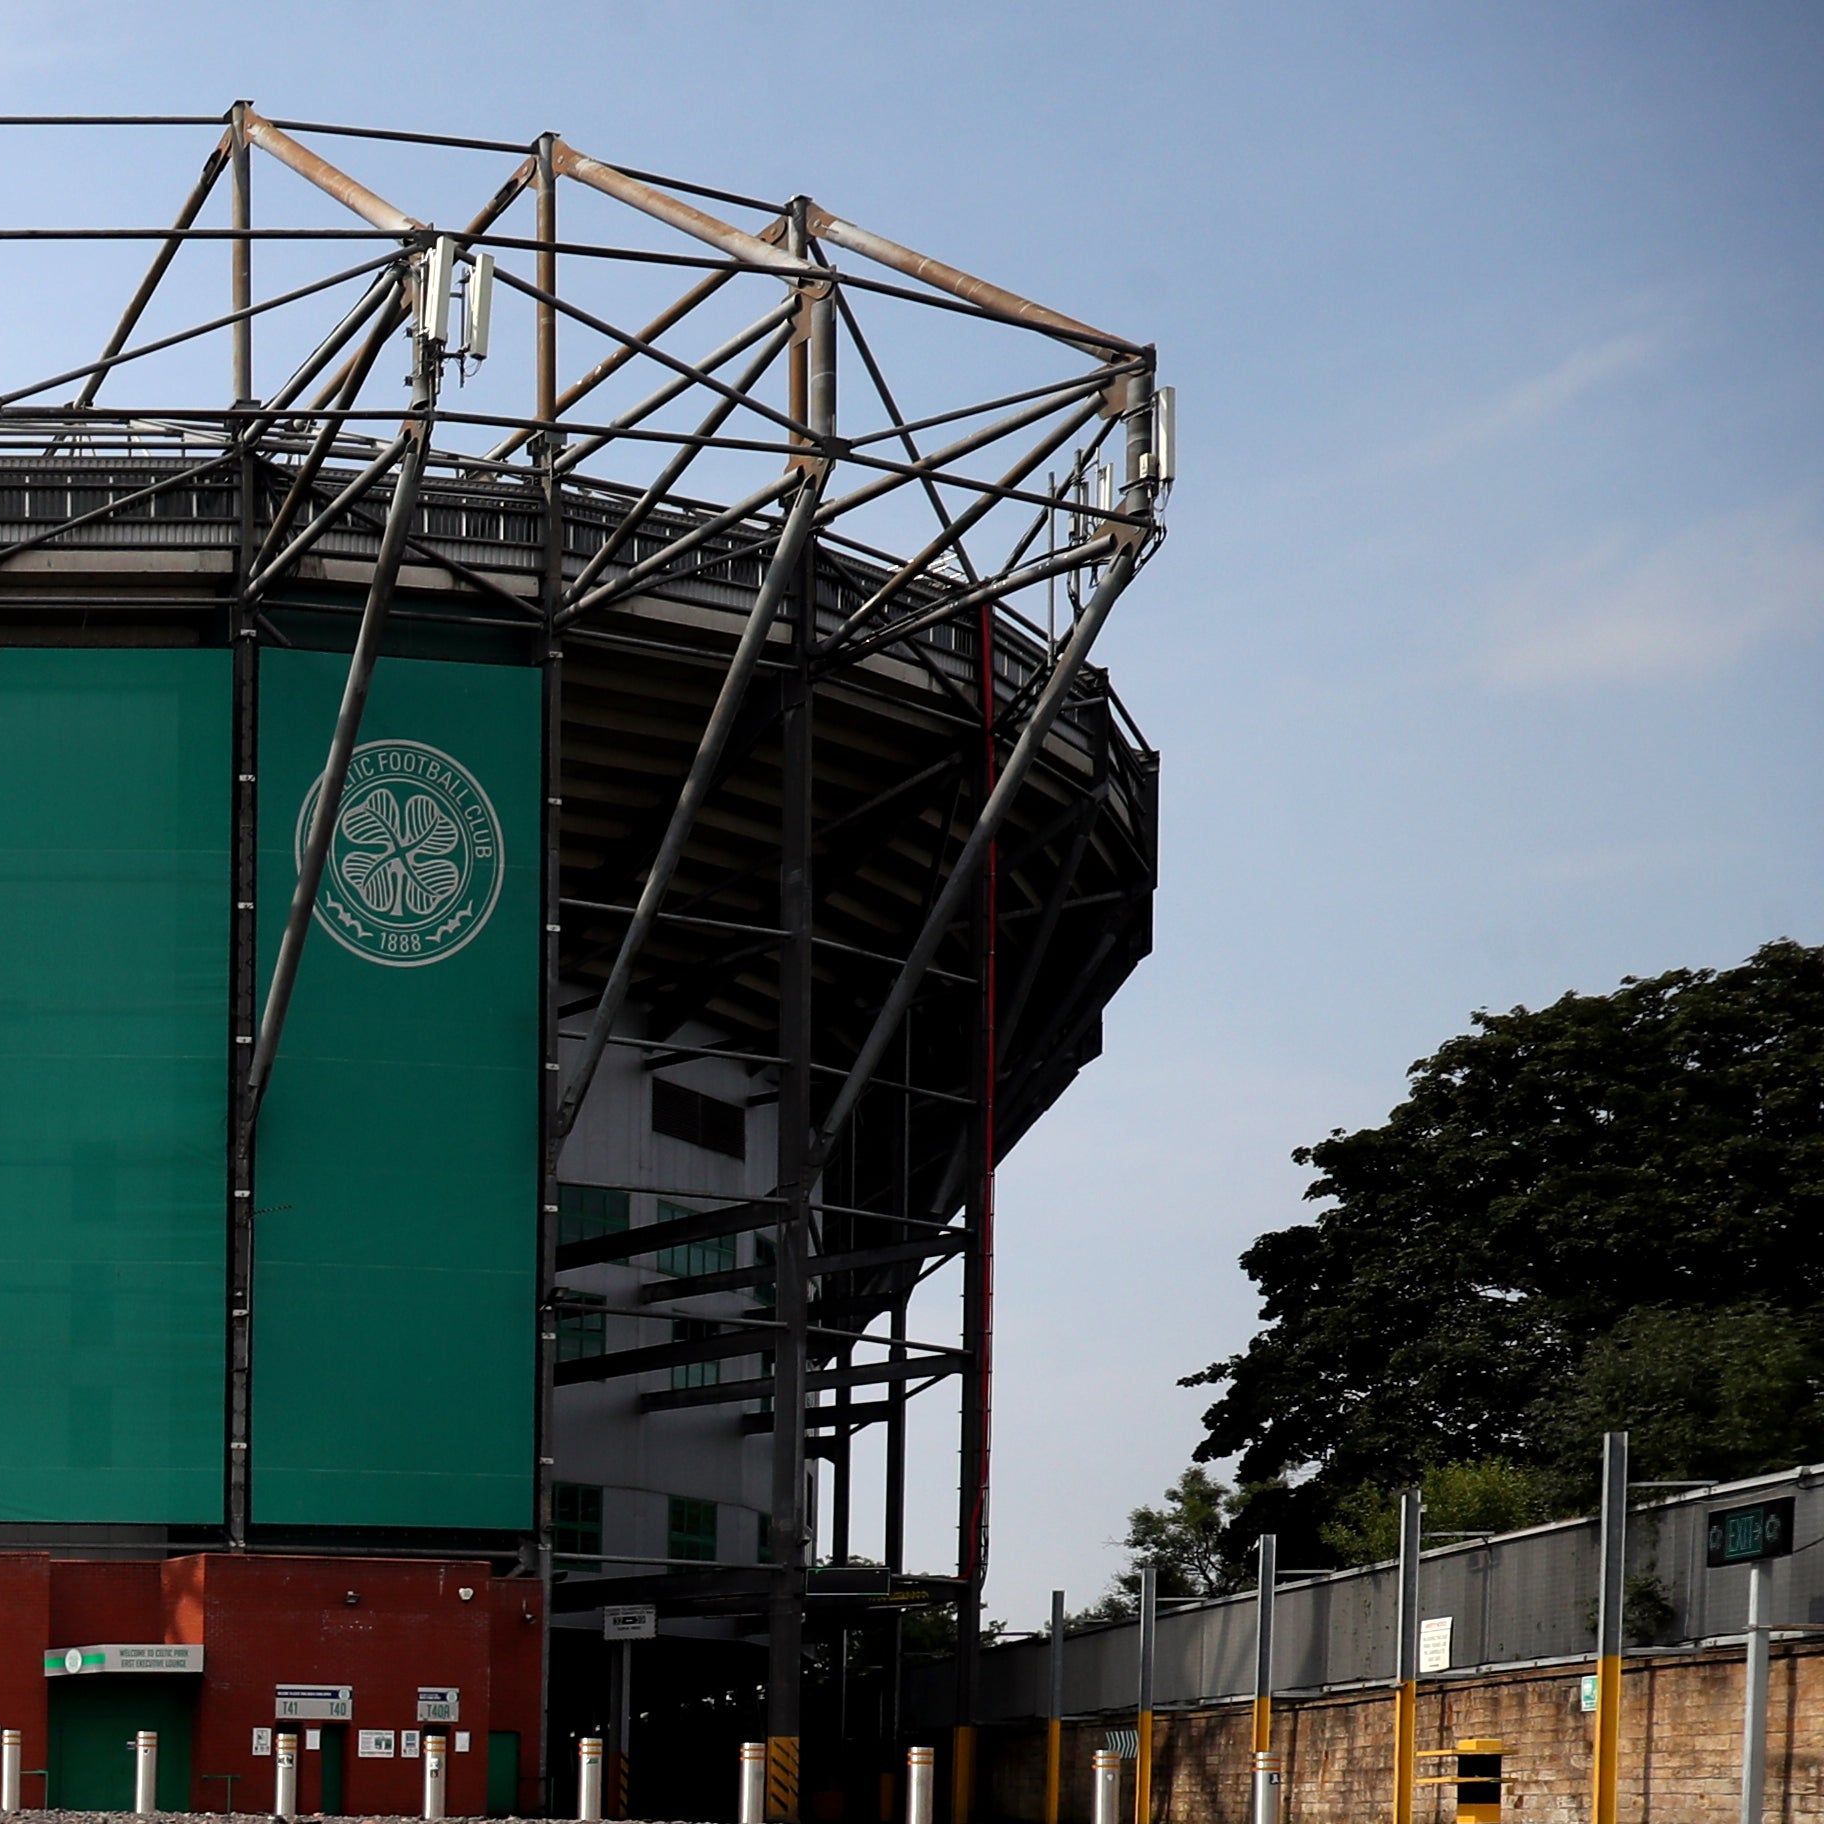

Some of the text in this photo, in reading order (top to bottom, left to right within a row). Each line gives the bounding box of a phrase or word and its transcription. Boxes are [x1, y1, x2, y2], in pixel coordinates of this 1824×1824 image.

[378, 751, 469, 806] FOOTBALL
[463, 804, 493, 859] CLUB
[379, 931, 422, 953] 1888
[282, 1701, 348, 1716] T41 T40
